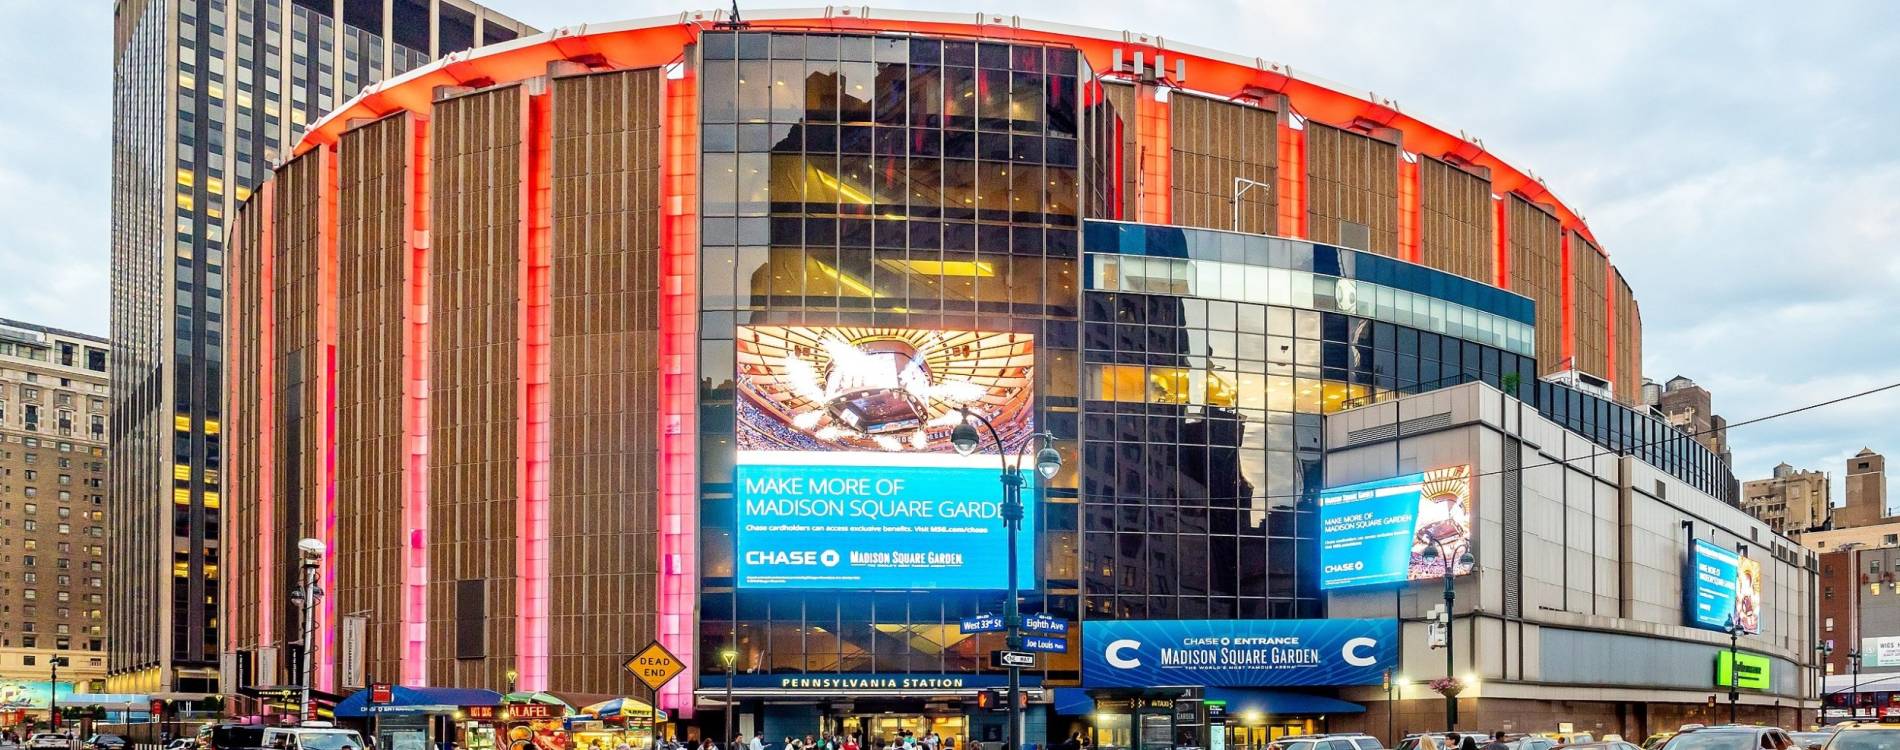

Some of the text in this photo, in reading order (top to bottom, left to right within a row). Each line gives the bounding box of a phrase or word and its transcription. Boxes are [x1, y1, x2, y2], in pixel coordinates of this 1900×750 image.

[745, 477, 904, 496] MAKE MORE OF
[745, 499, 844, 516] MADISON
[849, 500, 933, 519] SQUARE
[1325, 512, 1374, 526] MAKE MORE OF
[1325, 515, 1412, 533] MADISON SQUARE GARDEN
[746, 551, 817, 565] CHASE
[850, 551, 890, 564] MADISON
[892, 551, 925, 564] SQUARE
[1325, 561, 1354, 573] CHASE
[963, 620, 980, 631] West
[994, 618, 1002, 628] St
[1026, 618, 1064, 630] Eighth Ave
[1026, 639, 1037, 649] Joe
[1038, 640, 1054, 649] Louis
[1183, 637, 1299, 646] CHASE ENTRANCE
[1105, 639, 1141, 669] C
[1161, 648, 1217, 665] MADISON
[1221, 647, 1267, 665] SQUARE
[1342, 637, 1377, 667] C
[640, 657, 670, 666] DEAD
[644, 669, 666, 677] END
[782, 678, 963, 688] PENNSYLVANIA STATION
